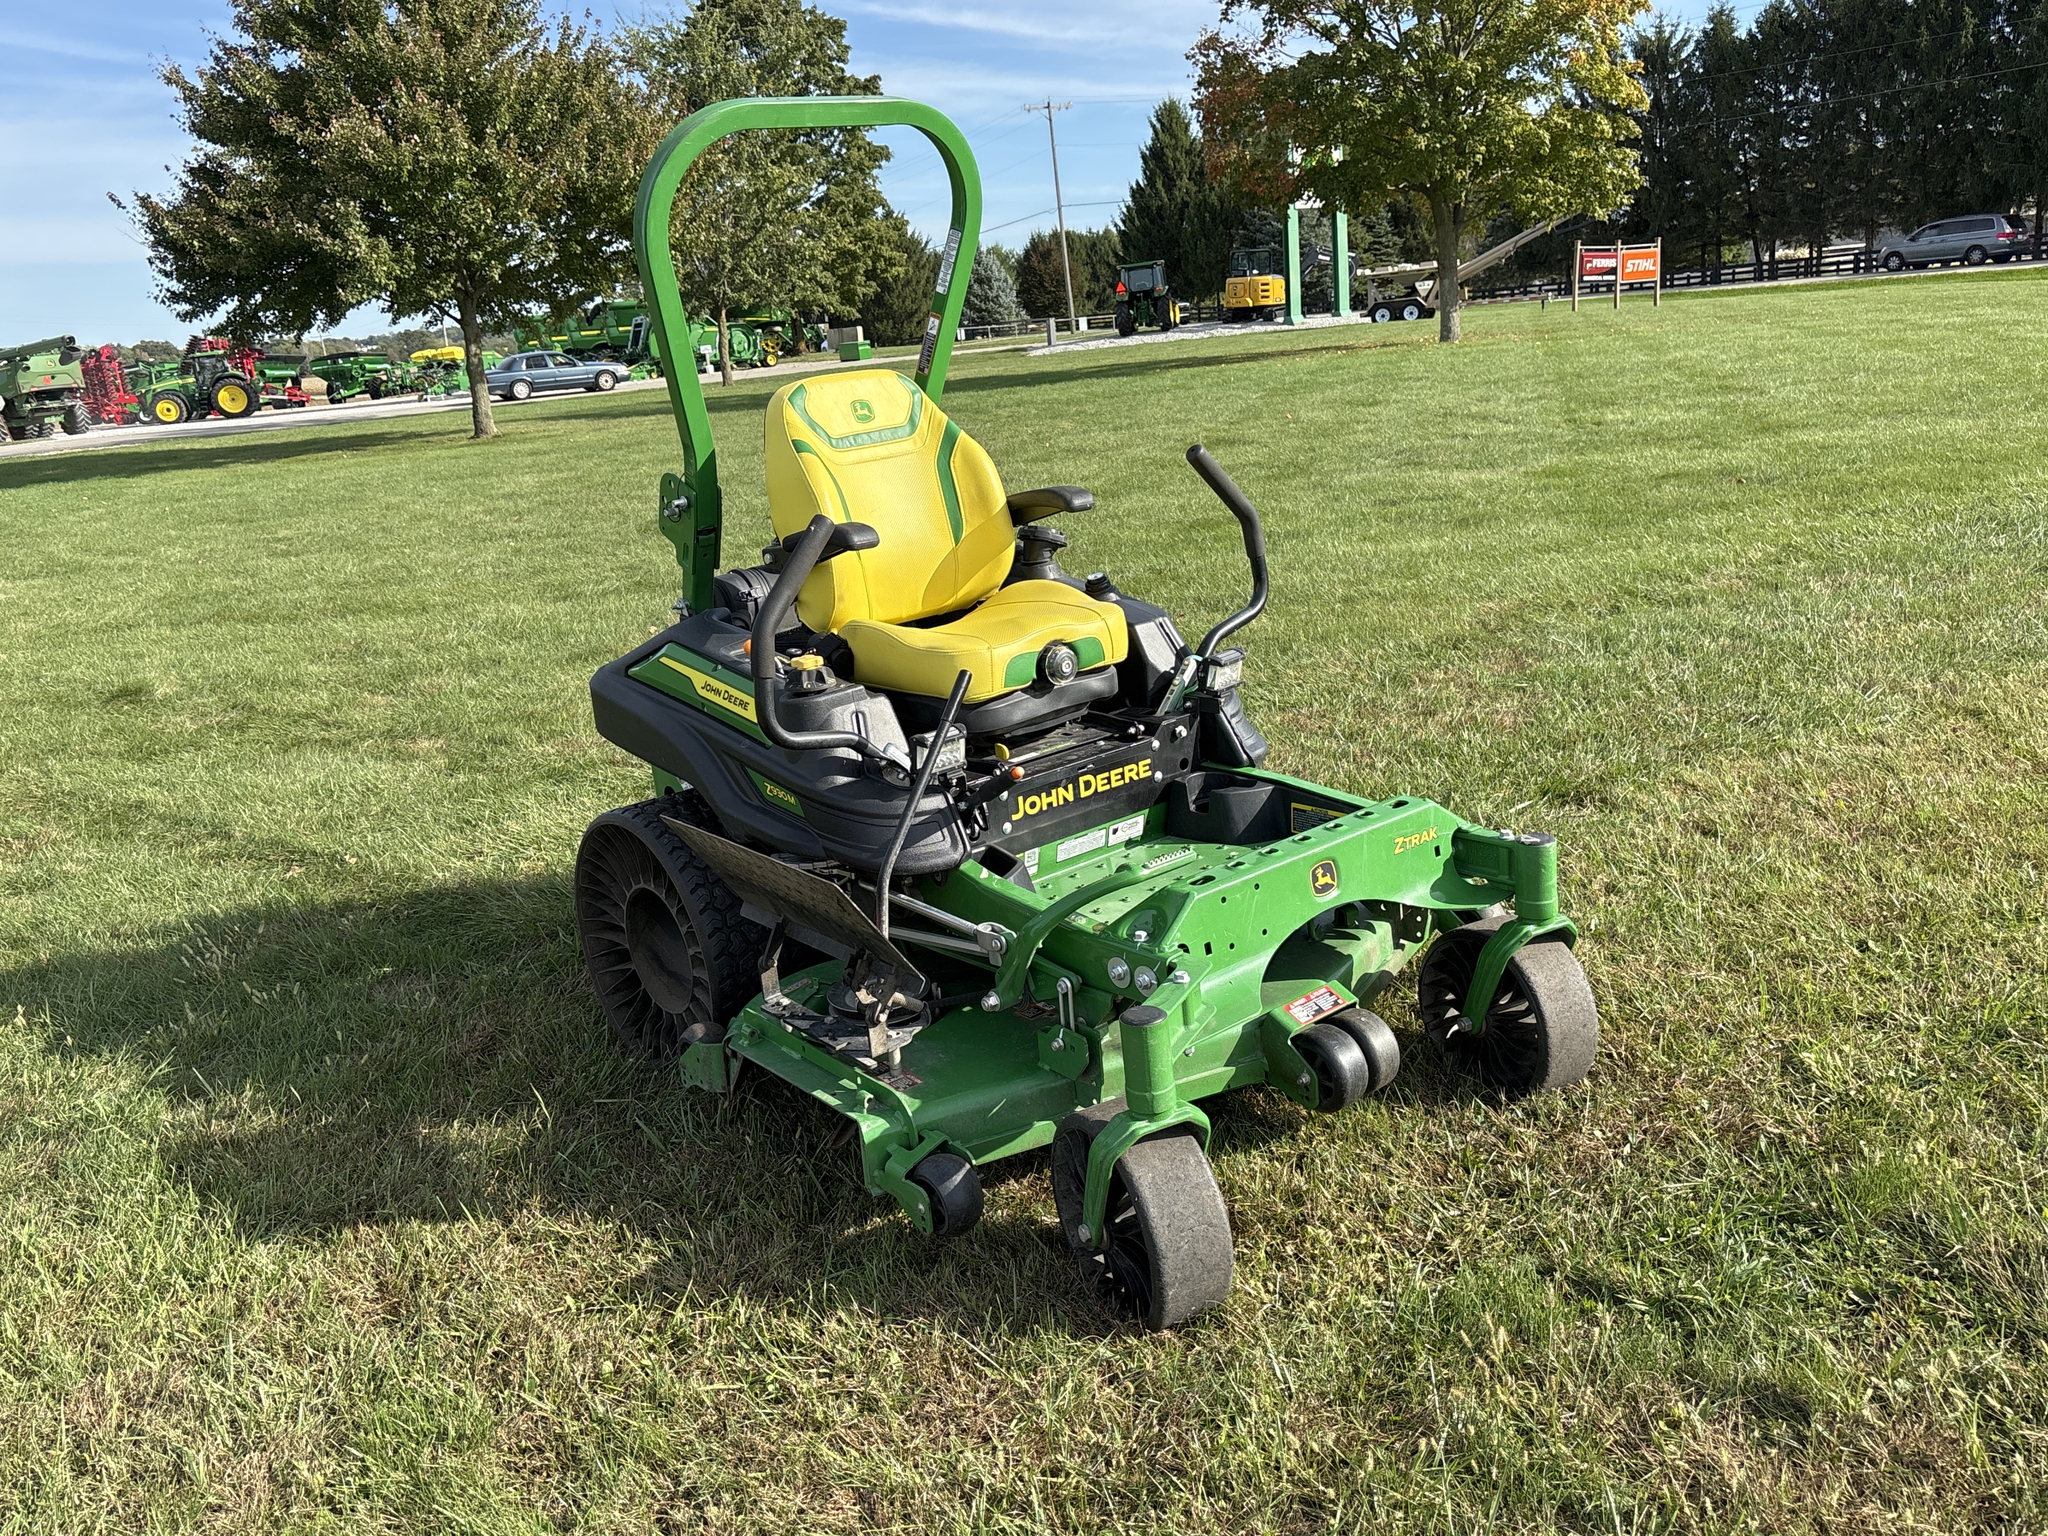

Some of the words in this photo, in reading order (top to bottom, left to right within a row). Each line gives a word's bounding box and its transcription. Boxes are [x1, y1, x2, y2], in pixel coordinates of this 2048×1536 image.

[1593, 258, 1617, 268] FERRIS
[1625, 258, 1656, 273] STIHL
[701, 680, 722, 698] JOHN
[722, 690, 750, 711] DEERE
[763, 782, 796, 805] Z930M
[1011, 783, 1074, 821] JOHN
[1079, 758, 1152, 798] DEERE
[1394, 825, 1438, 855] ZTRAK
